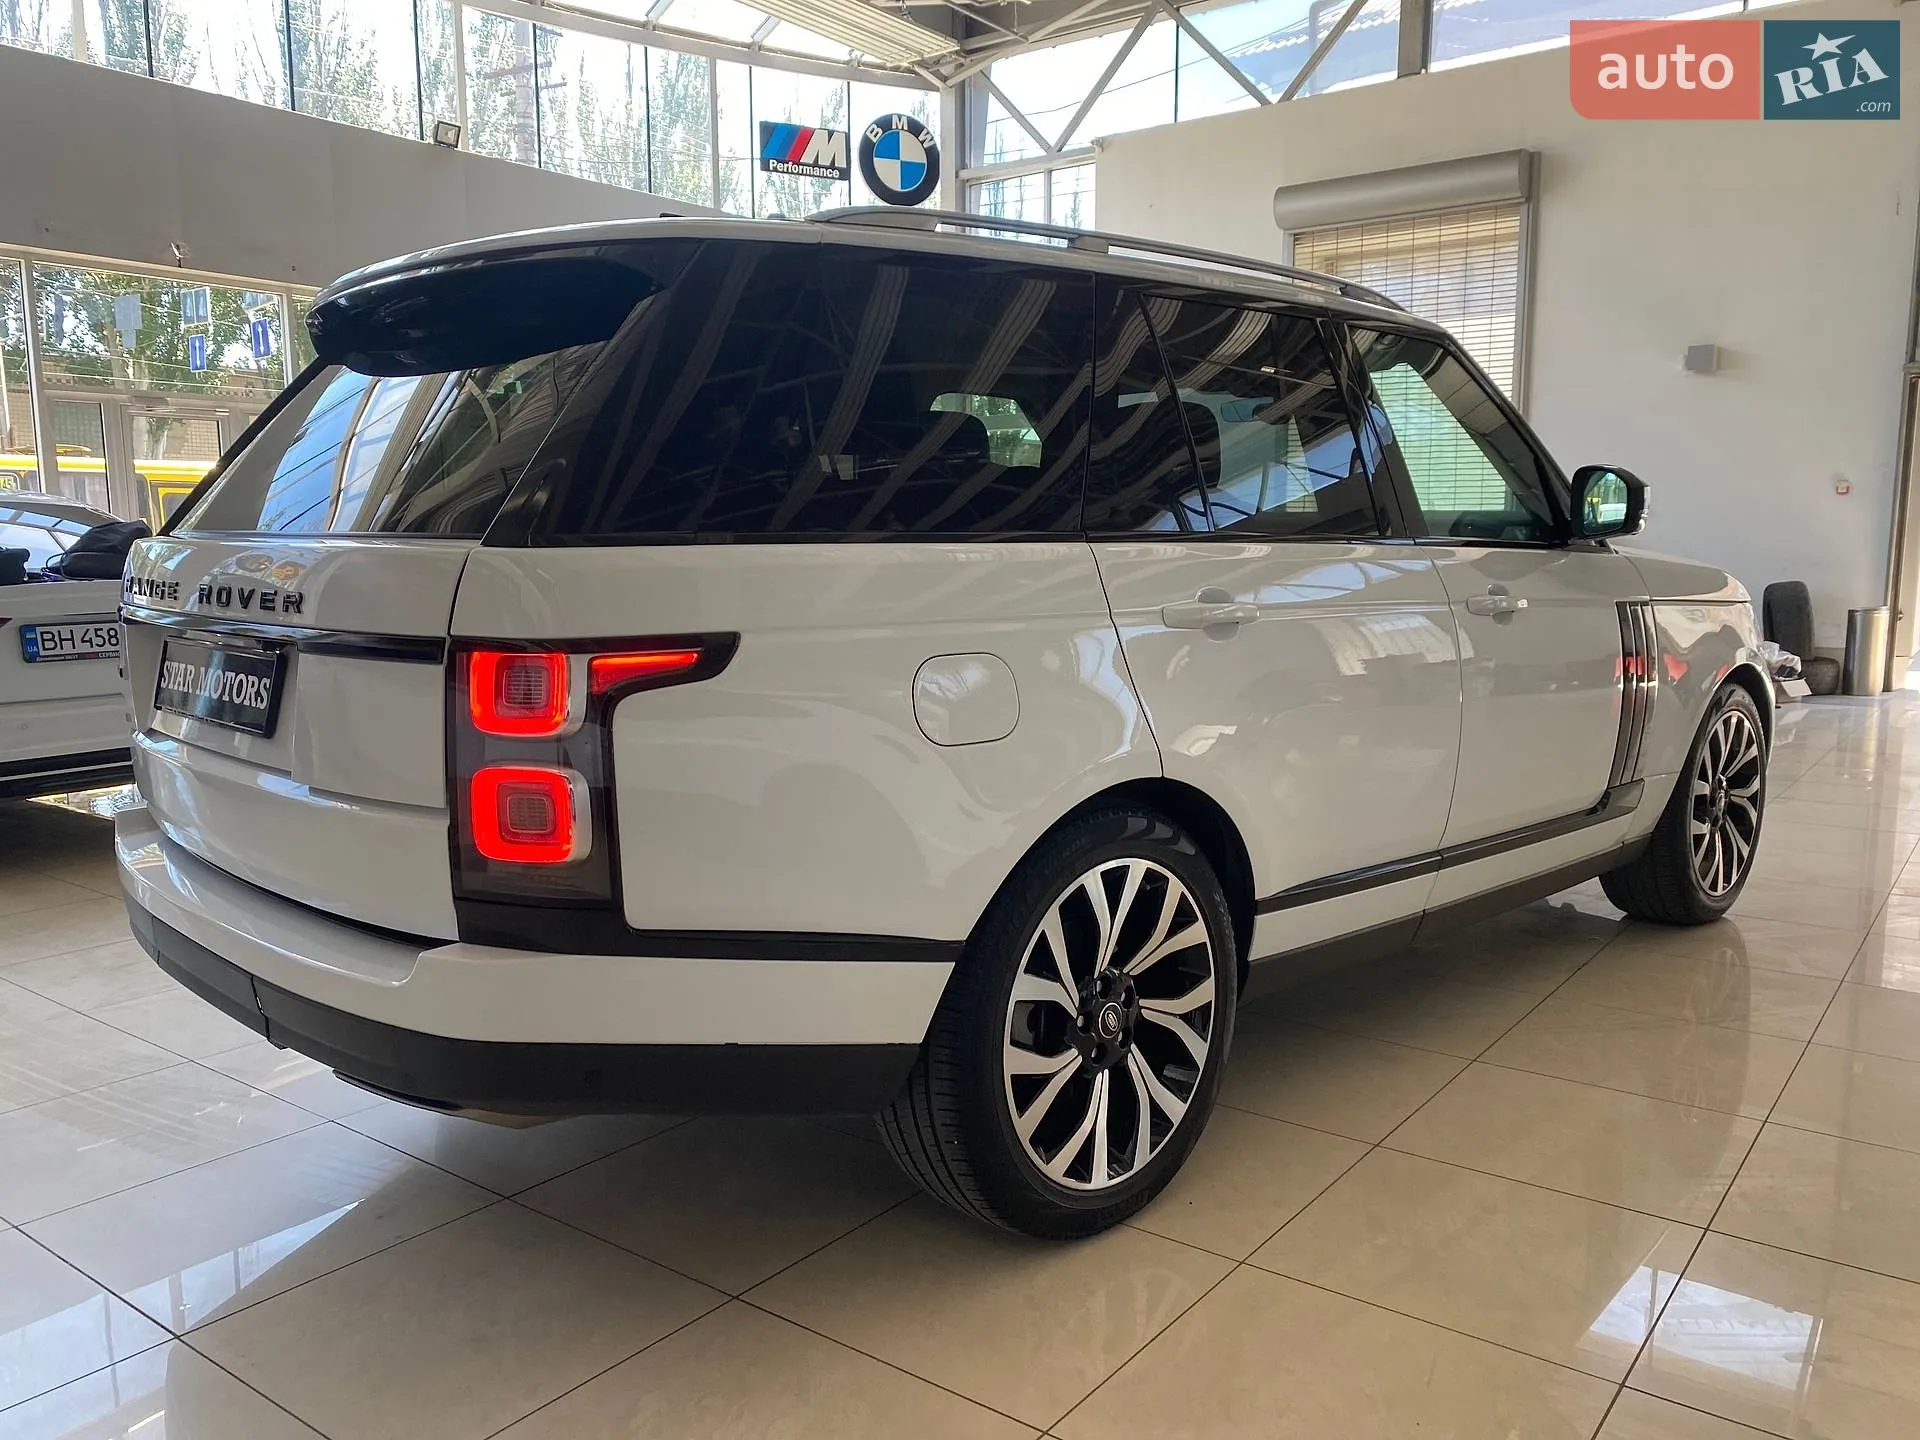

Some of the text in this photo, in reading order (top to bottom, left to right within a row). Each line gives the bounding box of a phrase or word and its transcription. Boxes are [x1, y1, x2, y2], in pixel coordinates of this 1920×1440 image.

[800, 128, 847, 168] M
[865, 114, 936, 149] BMW
[769, 159, 840, 178] Performance
[198, 583, 304, 614] ROVER
[40, 627, 119, 651] BH 458
[160, 660, 271, 710] STAR MOTORS
